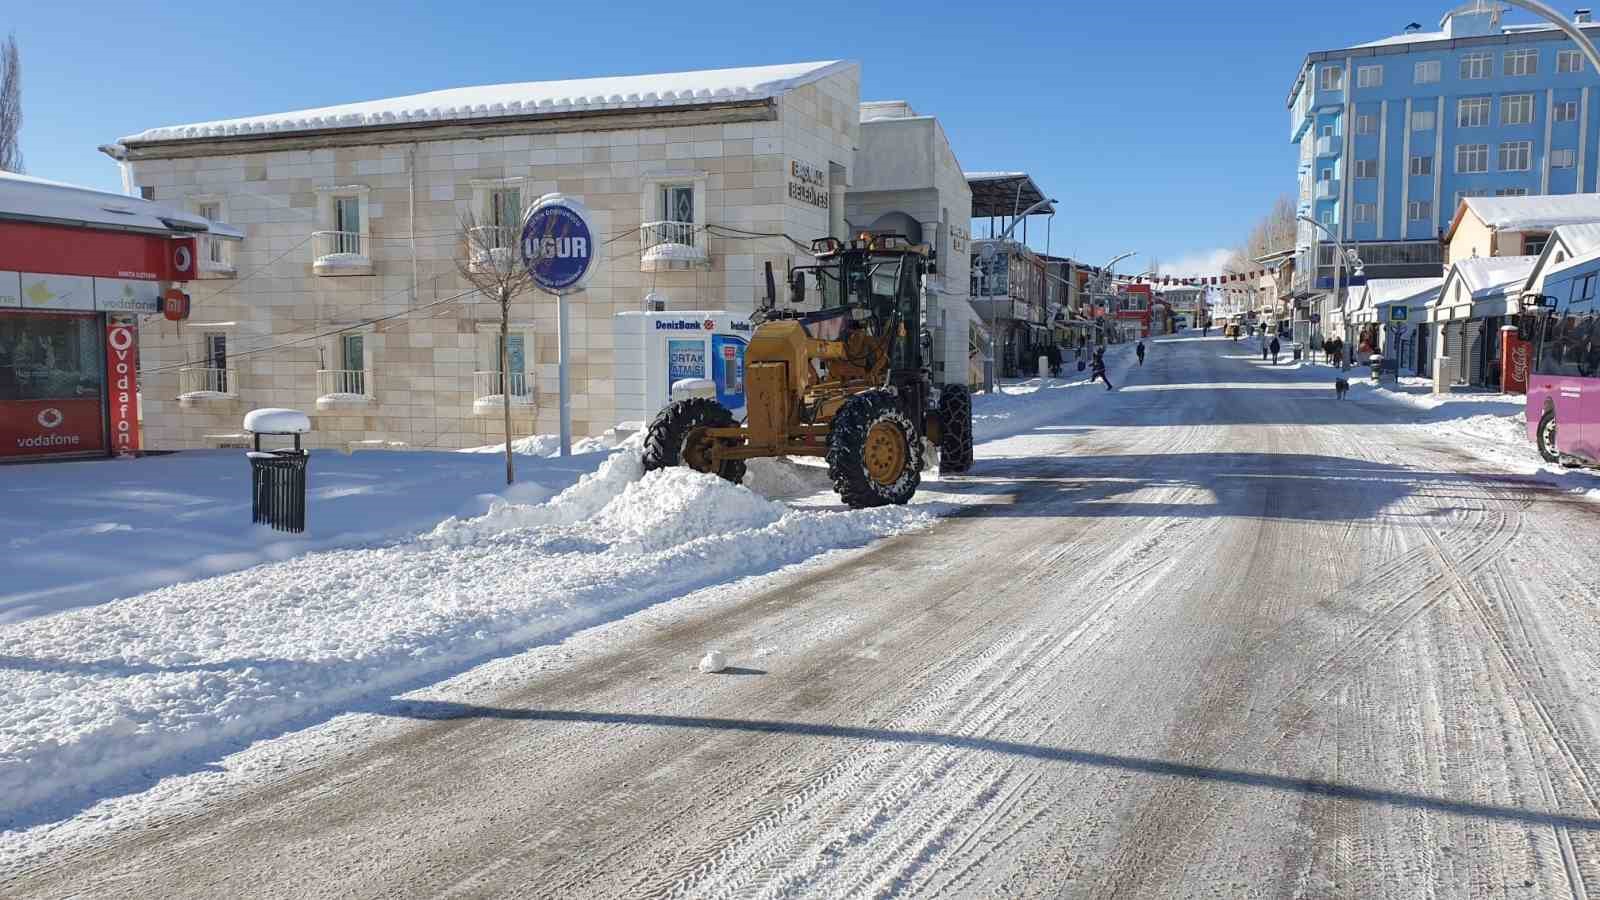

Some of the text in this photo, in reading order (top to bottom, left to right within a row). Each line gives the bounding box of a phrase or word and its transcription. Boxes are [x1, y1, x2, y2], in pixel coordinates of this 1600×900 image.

[525, 234, 587, 259] UĞUR
[656, 319, 701, 330] DenizBank
[115, 350, 130, 456] vodafone
[17, 433, 80, 447] vodafone
